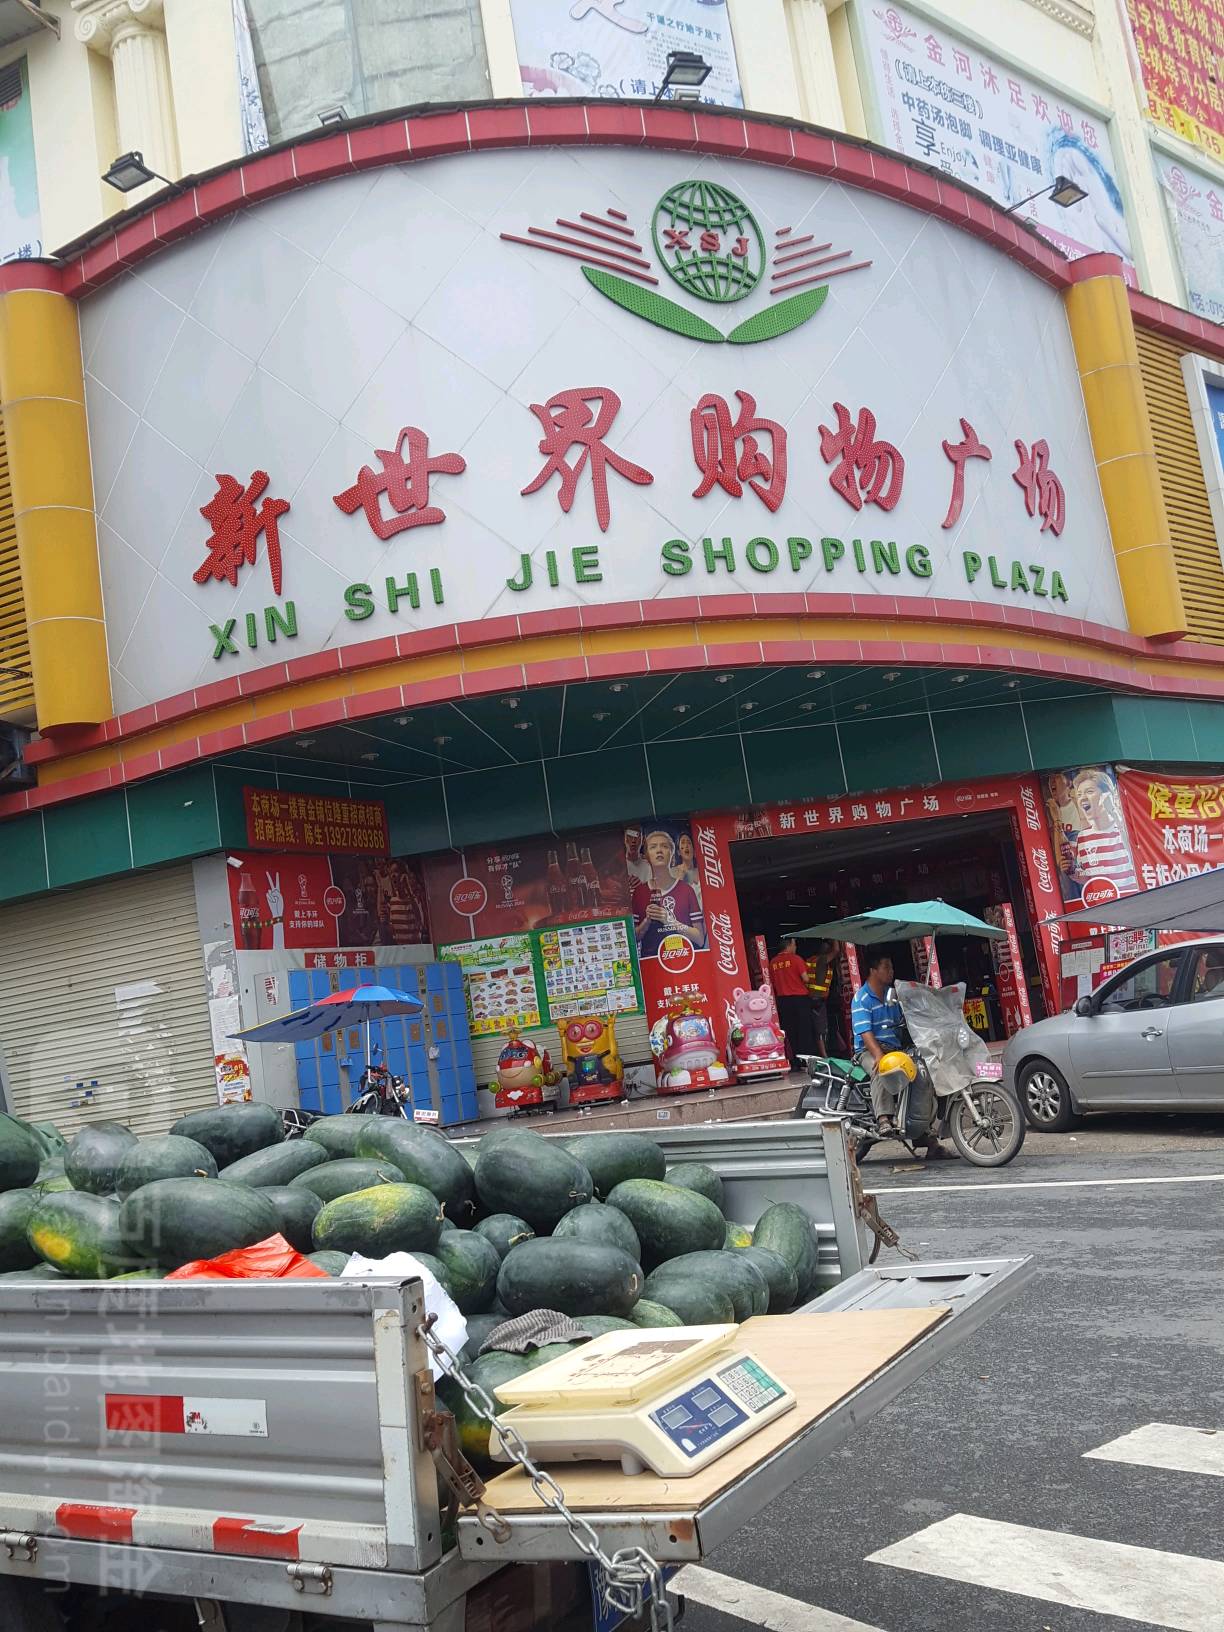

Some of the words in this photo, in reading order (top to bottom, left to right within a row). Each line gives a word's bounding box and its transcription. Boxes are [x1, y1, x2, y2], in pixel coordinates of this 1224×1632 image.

[924, 34, 1099, 149] 金河沐足欢迎您
[901, 91, 973, 141] 中药汤泡脚
[978, 127, 1044, 176] 调理亚健康
[911, 117, 941, 157] 享
[940, 142, 969, 167] Enjoy
[663, 227, 751, 258] XSJ
[193, 386, 1066, 595] 新世界购物广场
[209, 600, 298, 660] XIN
[344, 567, 444, 622] SHI
[506, 545, 603, 592] JIE
[661, 536, 934, 579] SHOPPING
[962, 551, 1070, 602] PLAZA
[779, 795, 940, 830] 新世界购物广场
[1020, 785, 1042, 831] 可口可乐
[1147, 782, 1224, 820] 隆重招
[697, 825, 724, 889] 可口可乐
[1032, 847, 1054, 893] Coca-Cola
[1085, 889, 1115, 902] 可口可乐
[313, 953, 367, 968] 储物柜
[710, 910, 738, 976] Coca-Cola
[663, 983, 700, 997] 戴上手环
